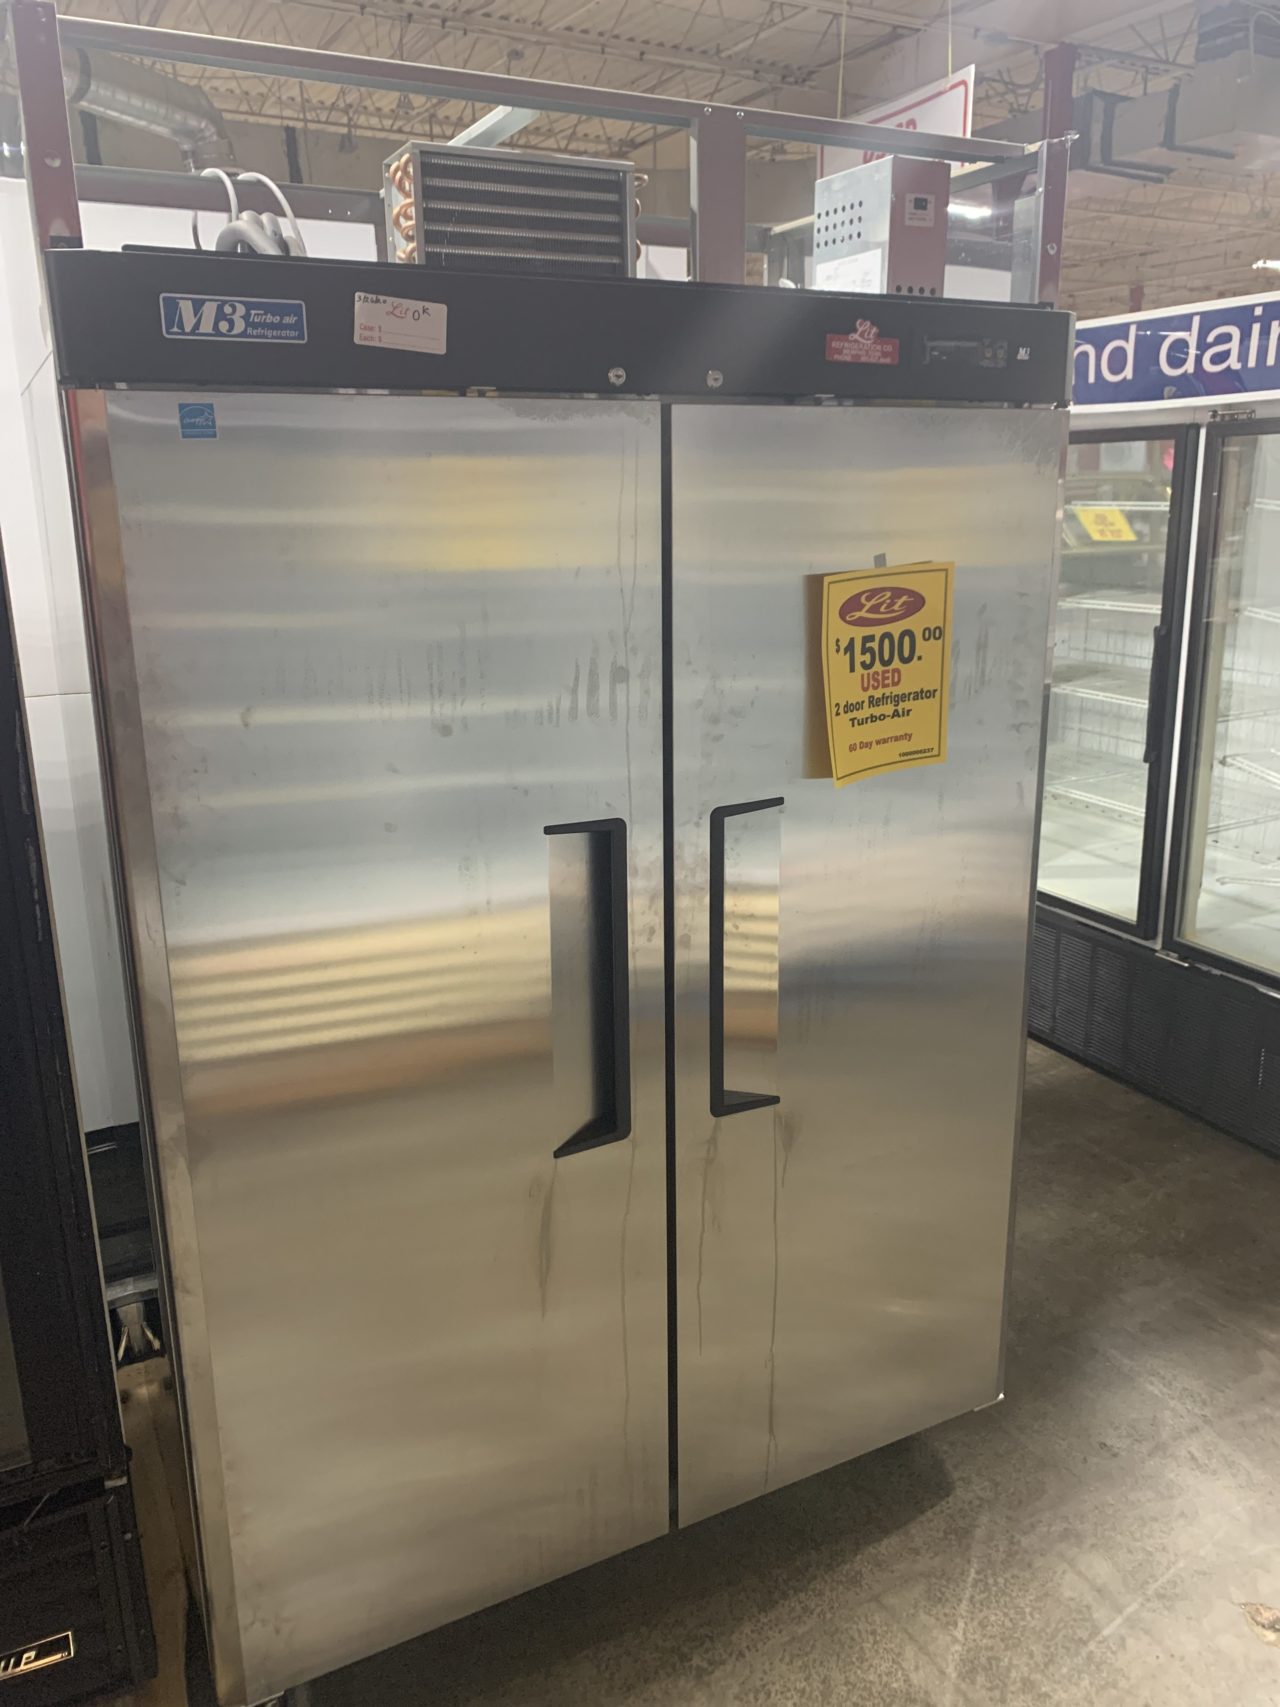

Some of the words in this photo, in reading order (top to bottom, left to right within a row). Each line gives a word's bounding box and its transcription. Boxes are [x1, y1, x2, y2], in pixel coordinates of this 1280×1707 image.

[169, 299, 246, 335] M3
[249, 310, 280, 323] Turbo
[282, 313, 298, 324] air
[247, 327, 299, 338] Refrigerator
[846, 591, 915, 621] Lit
[860, 667, 902, 692] USED
[834, 702, 841, 716] 2
[843, 700, 865, 714] door
[868, 688, 938, 708] Refrigerator
[849, 708, 912, 727] Turbo-Air
[859, 739, 873, 750] Day
[875, 732, 913, 746] warranty
